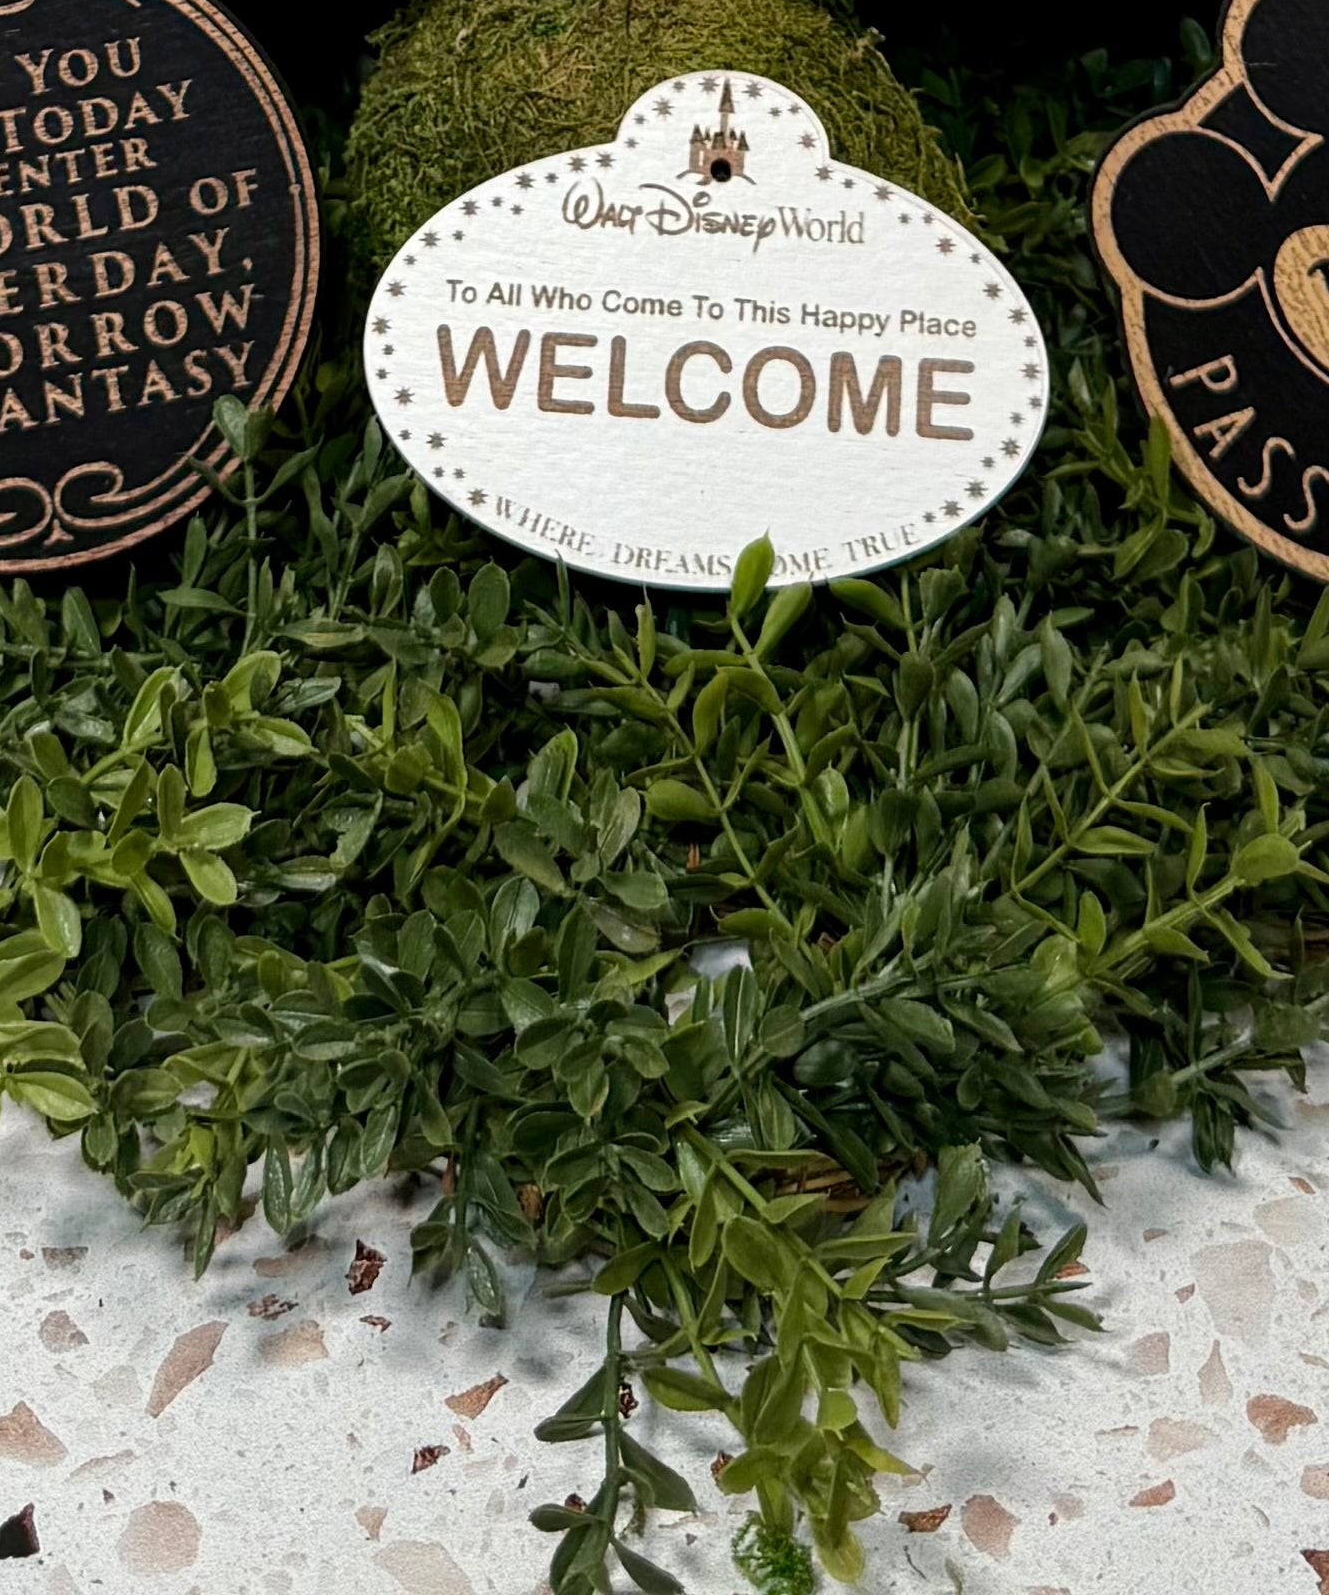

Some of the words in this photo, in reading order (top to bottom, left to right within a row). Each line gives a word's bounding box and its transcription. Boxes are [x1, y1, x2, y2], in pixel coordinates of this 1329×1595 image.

[14, 36, 142, 95] YOU
[188, 167, 259, 216] OF
[775, 206, 866, 245] World
[446, 279, 478, 304] To
[486, 281, 523, 307] All
[530, 284, 593, 311] Who
[601, 289, 684, 318] Come
[691, 294, 725, 320] To
[733, 297, 792, 325] This
[800, 303, 891, 338] Happy
[899, 309, 978, 339] Place
[435, 322, 976, 442] WELCOME
[494, 494, 596, 556] WHERE
[610, 541, 732, 577] DREAMS
[772, 546, 834, 578] OME
[841, 522, 921, 563] TRUE
